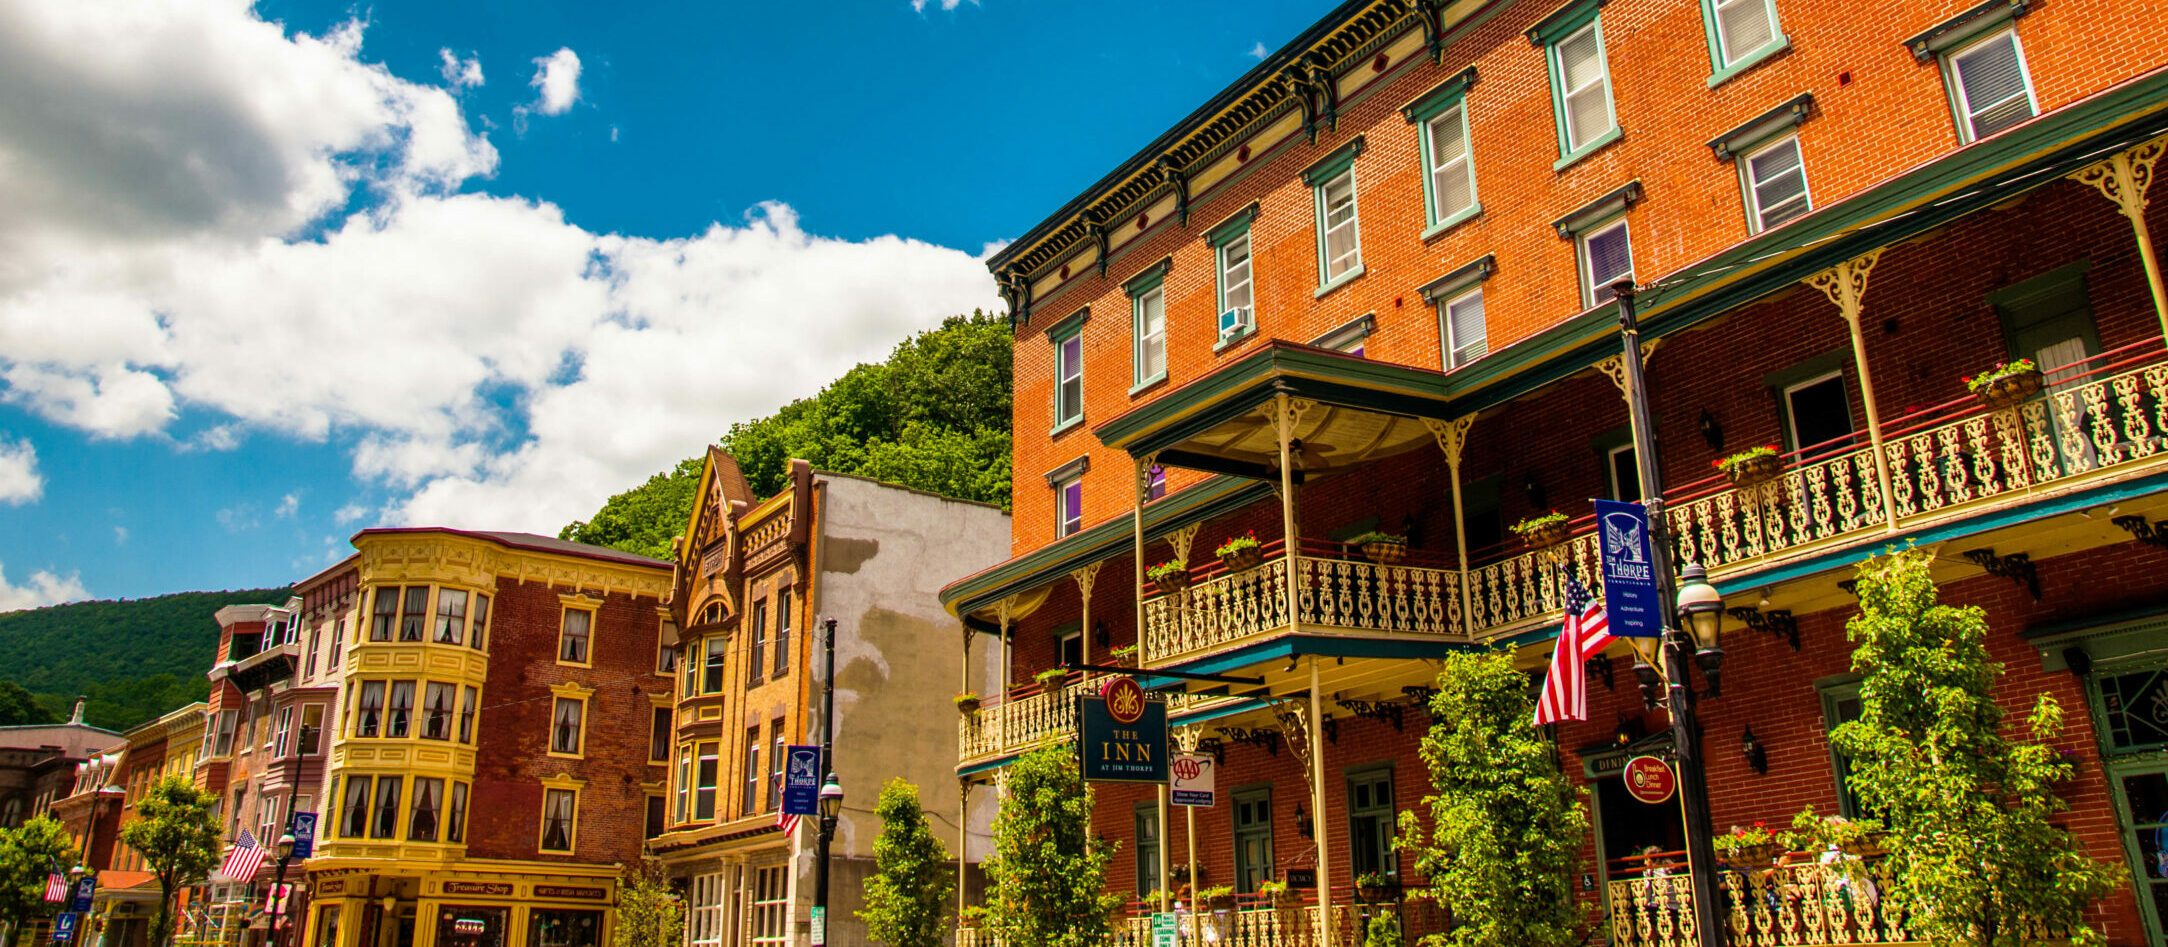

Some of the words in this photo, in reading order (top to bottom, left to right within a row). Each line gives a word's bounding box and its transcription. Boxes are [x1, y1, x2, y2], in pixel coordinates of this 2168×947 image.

[1608, 558, 1650, 580] THORPE
[1113, 730, 1139, 740] THE
[1101, 742, 1152, 762] INN
[1175, 759, 1199, 780] AAA
